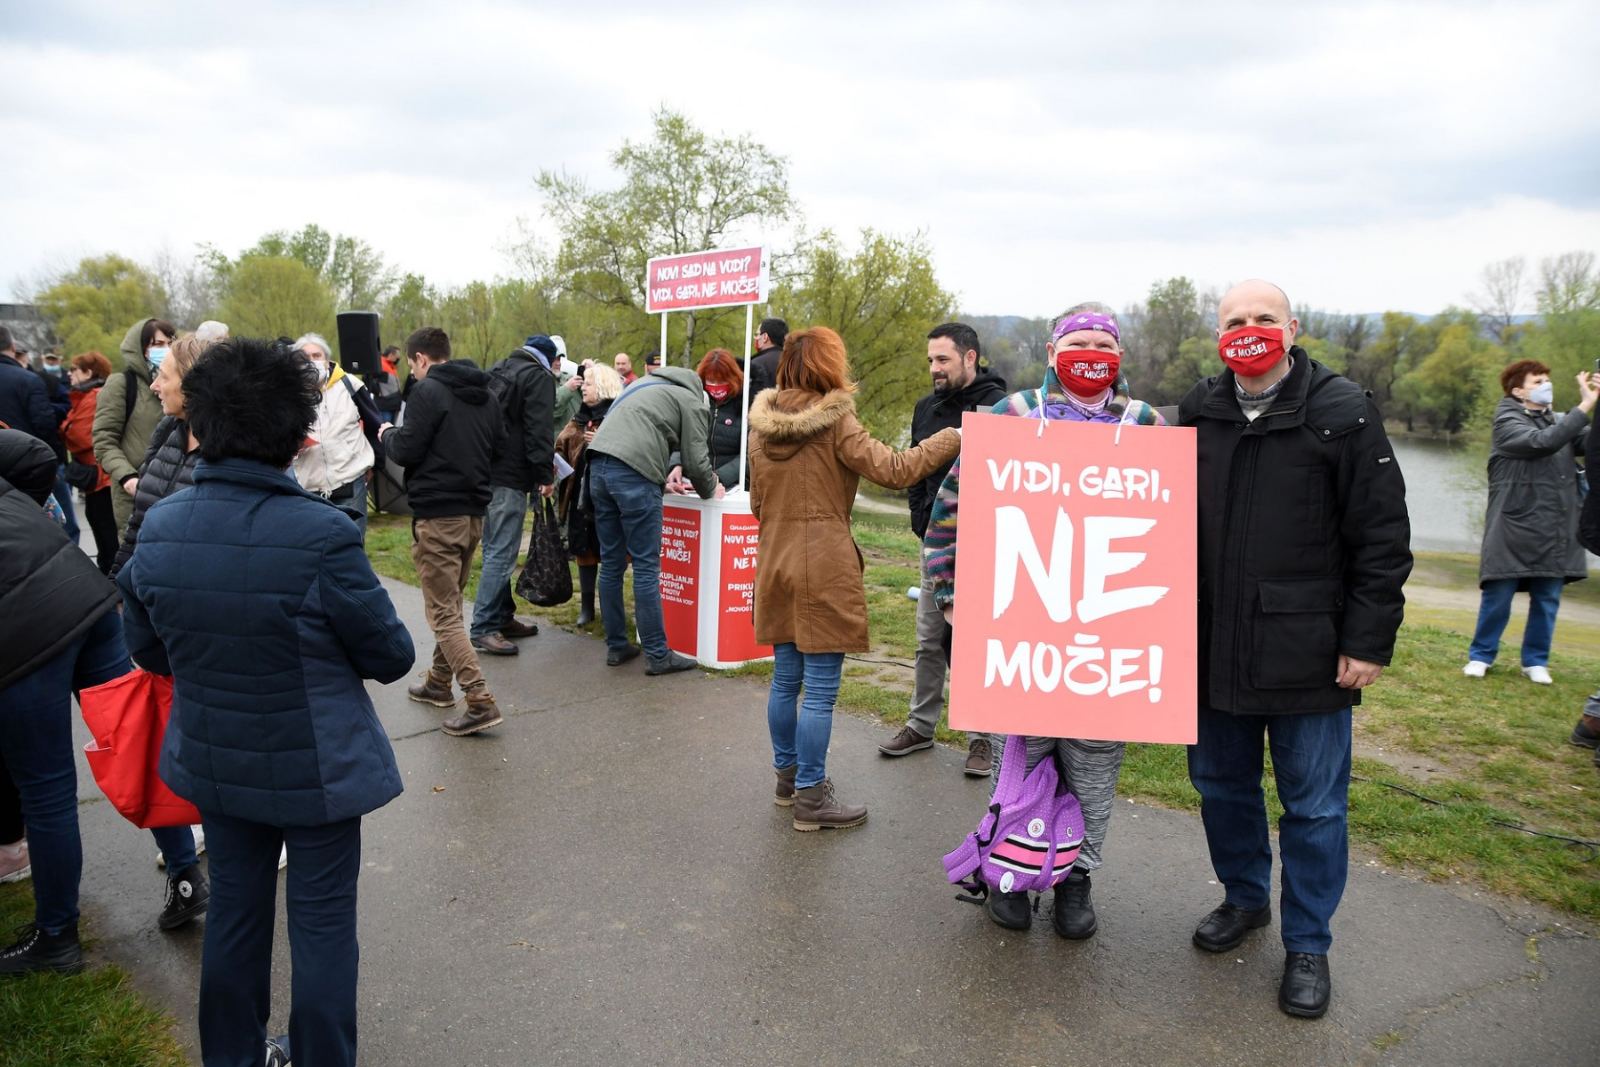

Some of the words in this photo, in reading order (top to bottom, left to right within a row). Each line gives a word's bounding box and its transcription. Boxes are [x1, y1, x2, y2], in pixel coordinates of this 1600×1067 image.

[657, 265, 679, 282] NOVI
[681, 264, 701, 278] SAD
[702, 261, 716, 277] NA
[719, 255, 752, 274] VODI?
[652, 287, 673, 302] VIDI,
[675, 284, 700, 300] GARI,
[701, 282, 718, 298] NE
[720, 275, 760, 296] MOŽE!
[1070, 368, 1083, 376] NE
[986, 459, 1071, 497] VIDI,
[1078, 465, 1171, 503] GARI,
[724, 534, 744, 544] NOVI
[733, 557, 750, 570] NE
[992, 504, 1171, 624] NE
[984, 632, 1164, 704] MOŽE!
